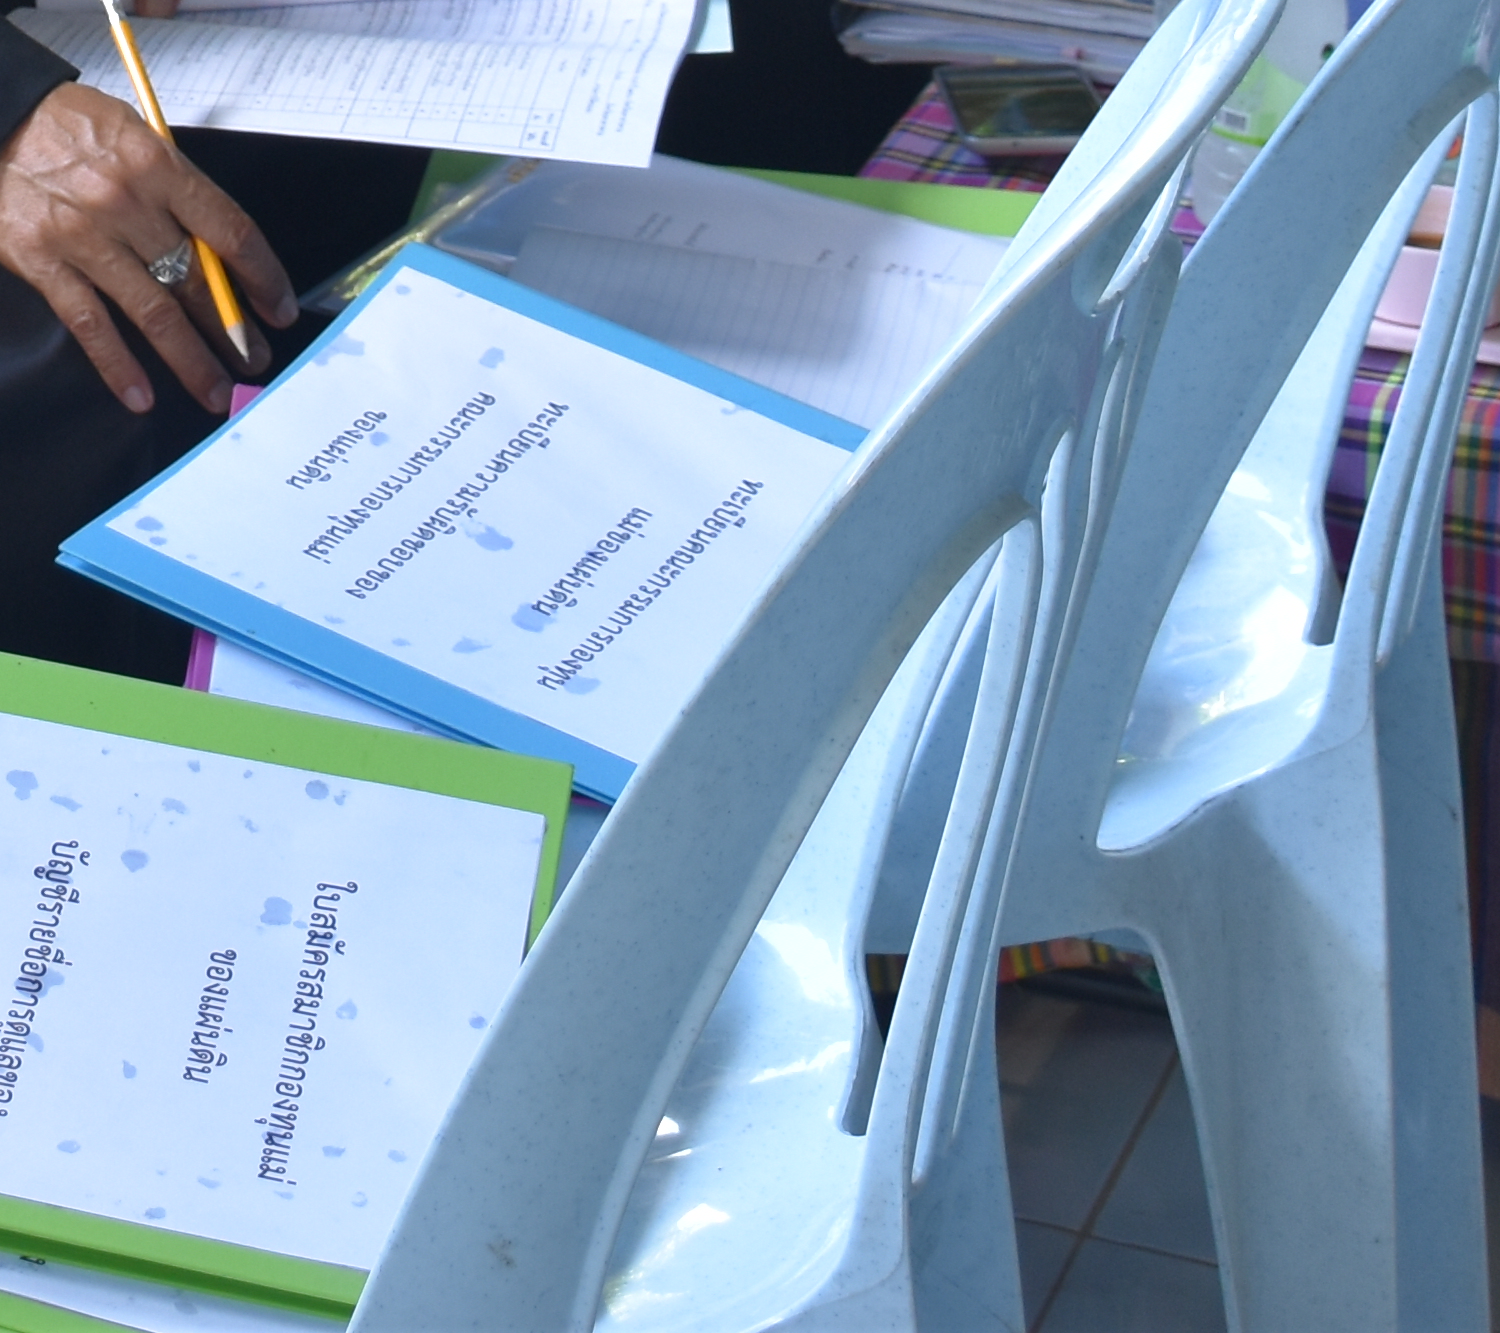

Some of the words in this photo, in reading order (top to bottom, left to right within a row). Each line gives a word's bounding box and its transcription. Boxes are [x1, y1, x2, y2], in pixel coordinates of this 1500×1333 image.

[285, 411, 389, 491] ของแผ่นดิน
[302, 391, 496, 565] คณะกรรมการกองทุนแม่
[345, 402, 570, 600] ทะเบียนความรับผิดชอบของ
[530, 507, 653, 617] แม่ของแผ่นดิน
[536, 479, 764, 691] ทะเบียนคณะกรรมการกองทุน
[182, 949, 238, 1085] ของแผ่นดิน
[256, 881, 360, 1186] ใบสมัครสมาชิกกองทุนแม่
